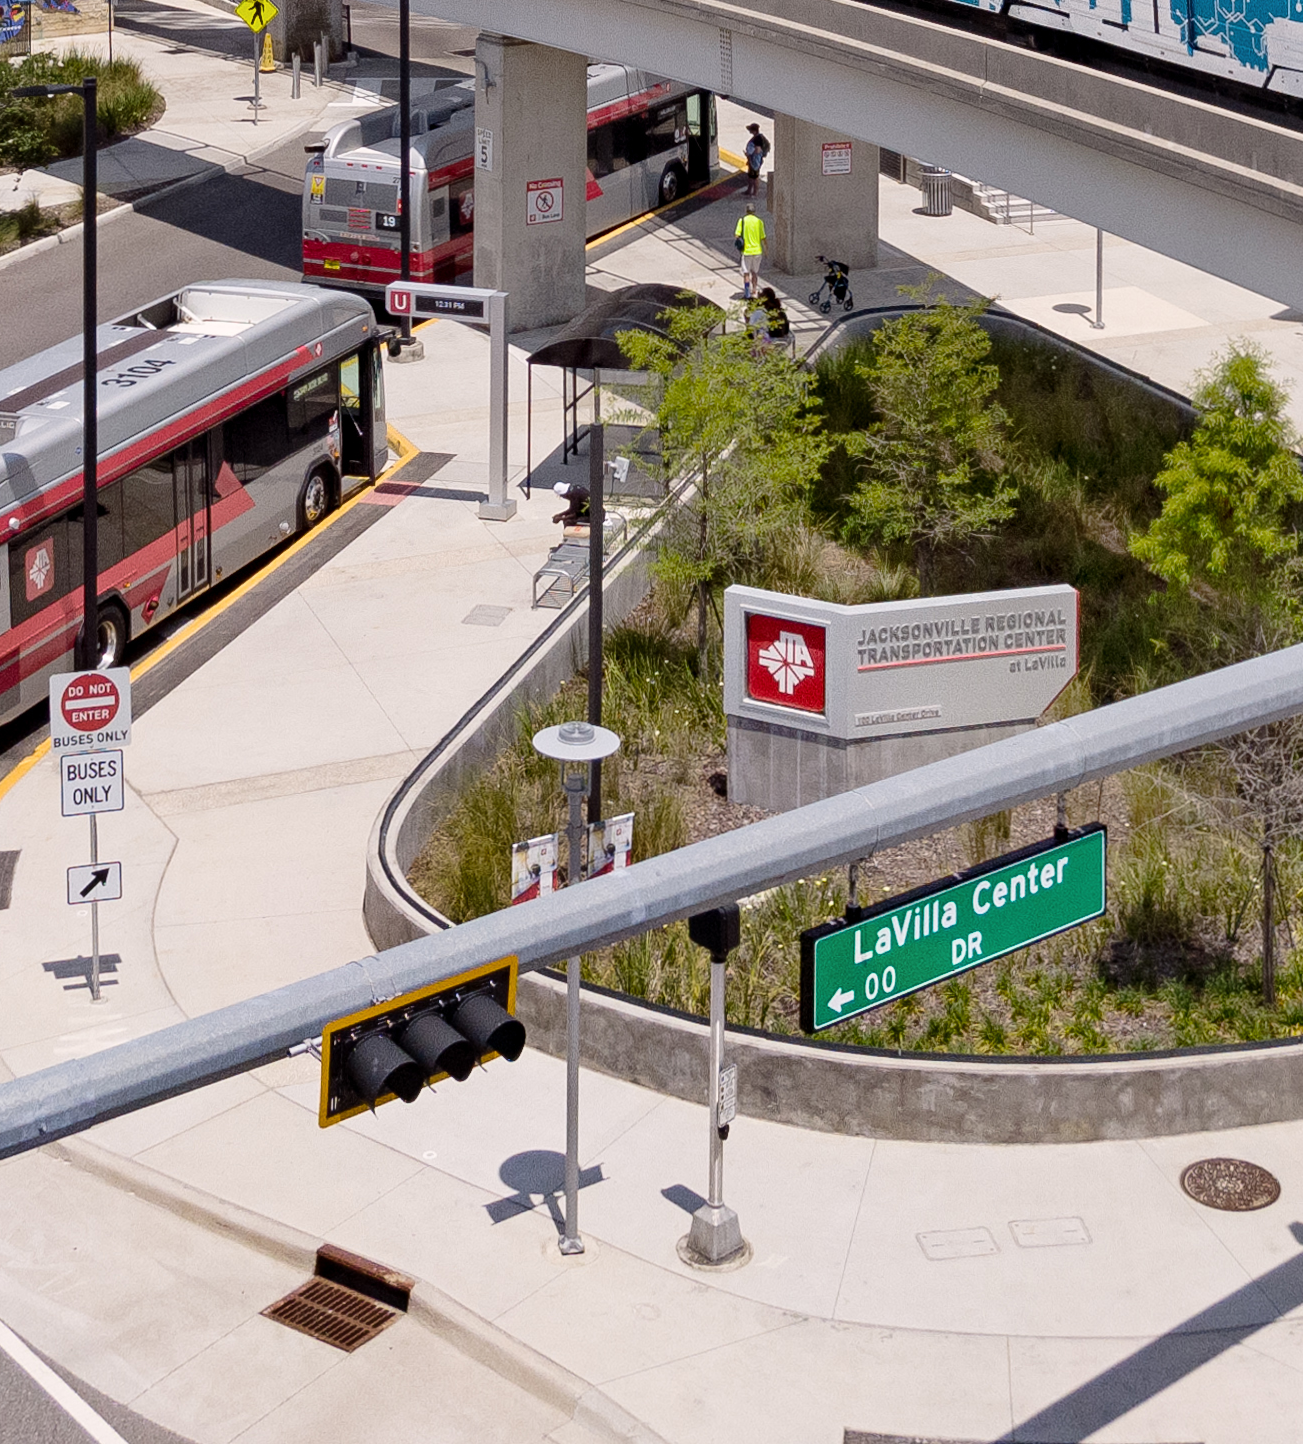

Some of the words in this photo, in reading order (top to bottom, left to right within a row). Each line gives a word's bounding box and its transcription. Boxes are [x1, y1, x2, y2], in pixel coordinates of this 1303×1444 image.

[481, 145, 488, 163] 5
[383, 216, 396, 227] 19
[394, 294, 407, 310] U
[101, 359, 176, 387] 3104
[857, 617, 980, 646] JACKSONVILLE
[985, 609, 1067, 633] REGIONAL
[857, 634, 999, 666] TRANSPORTATION
[1003, 627, 1067, 650] CENTER
[1009, 660, 1023, 673] at
[1024, 656, 1067, 672] LaVilla
[68, 686, 84, 698] DO
[89, 683, 112, 695] NOT
[71, 708, 110, 723] ENTER
[53, 734, 94, 748] BUSES
[97, 729, 128, 743] ONLY
[67, 759, 117, 782] BUSES
[73, 784, 112, 806] ONLY
[854, 901, 957, 964] LaVilla
[972, 856, 1069, 915] Center
[865, 966, 896, 1000] 00
[951, 931, 983, 965] DR
